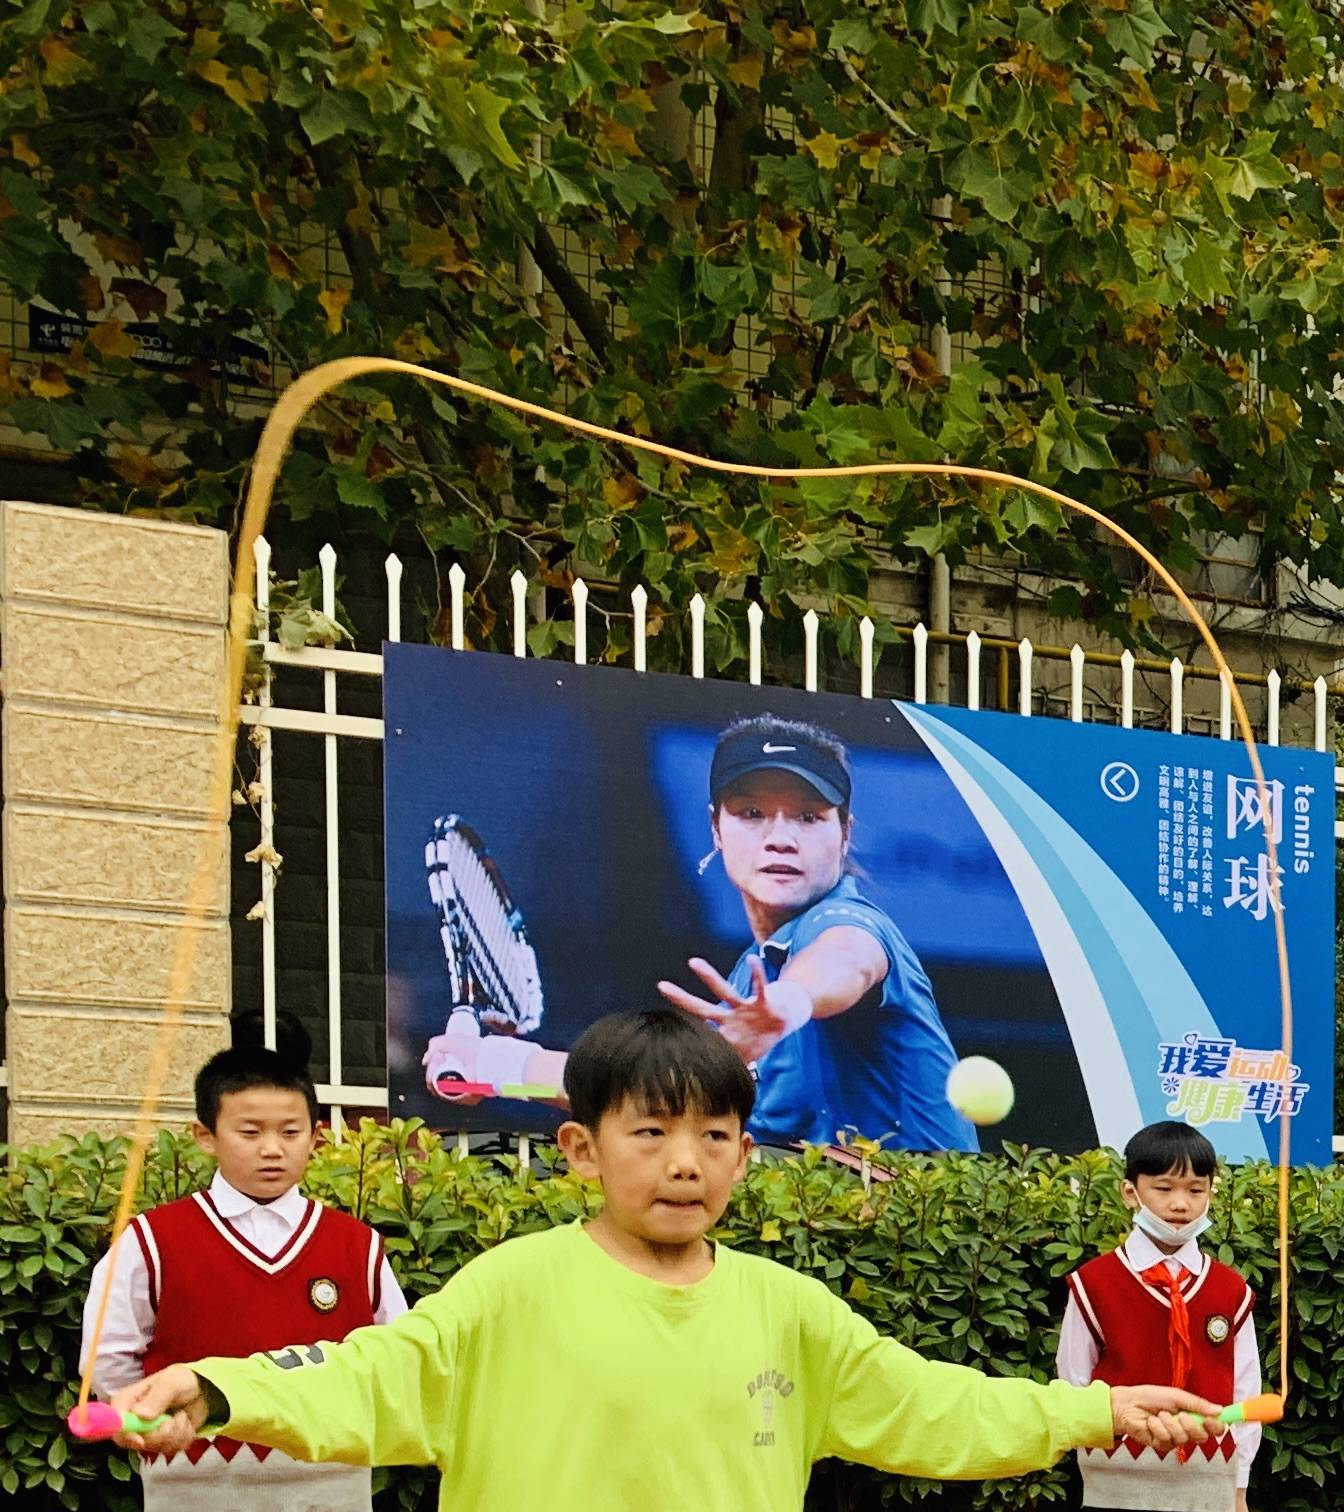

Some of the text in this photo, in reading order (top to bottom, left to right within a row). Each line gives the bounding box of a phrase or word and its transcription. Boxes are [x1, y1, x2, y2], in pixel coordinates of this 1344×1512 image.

[1223, 774, 1286, 921] 网球
[1294, 784, 1315, 874] tennis
[1159, 1039, 1291, 1080] 我爱运动
[1167, 1080, 1308, 1124] 健康生活
